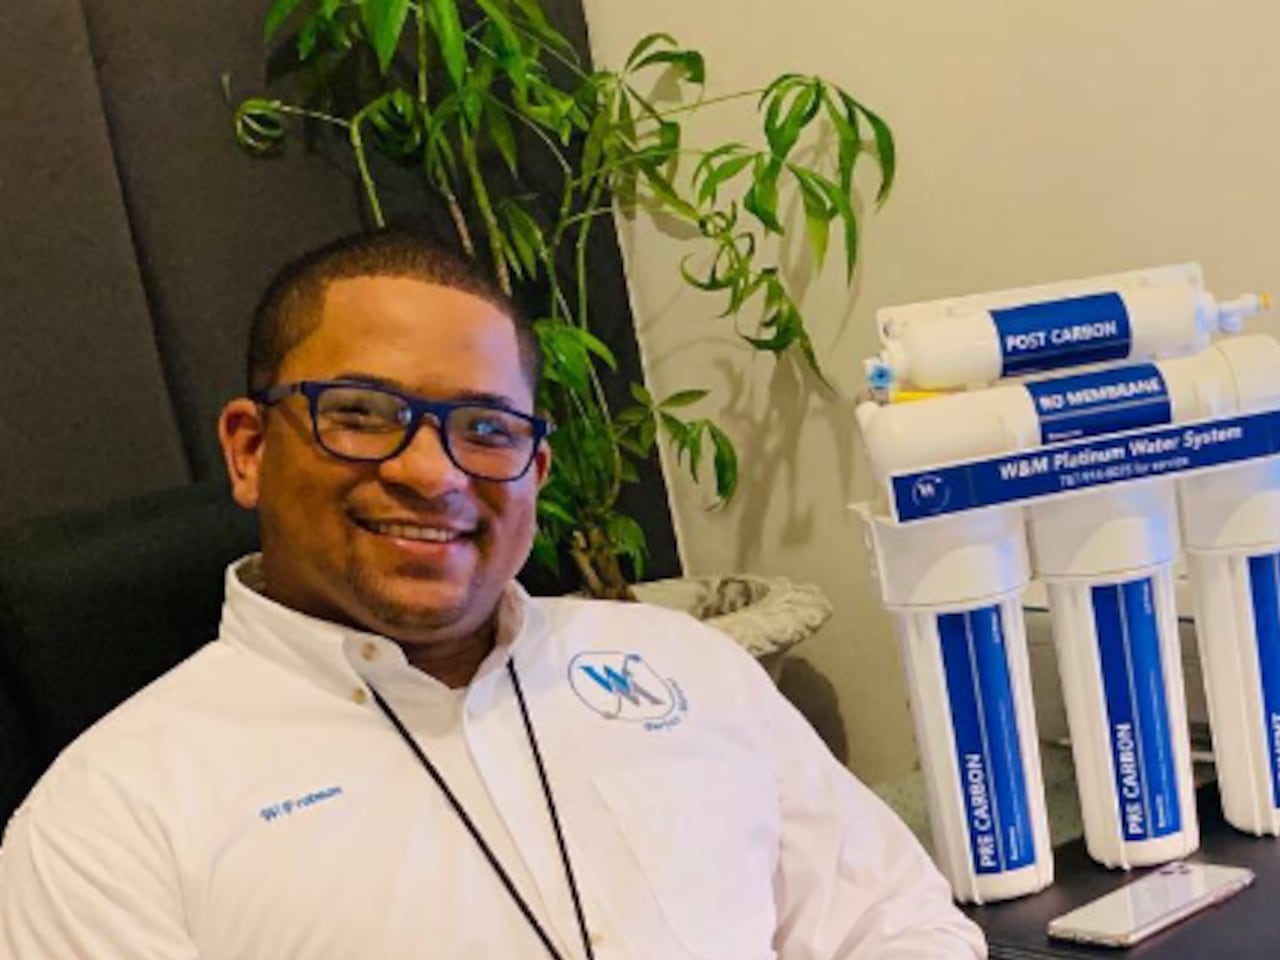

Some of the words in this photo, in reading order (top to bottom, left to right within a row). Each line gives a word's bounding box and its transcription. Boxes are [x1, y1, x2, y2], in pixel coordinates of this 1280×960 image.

[1006, 332, 1047, 352] POST
[1051, 320, 1118, 345] CARBON
[1066, 376, 1162, 405] MEMBRANE
[1054, 447, 1126, 471] Platinum
[1128, 436, 1180, 457] Water
[1182, 426, 1243, 451] System
[1116, 723, 1142, 800] CARBON
[964, 753, 992, 830] CARBON
[1125, 801, 1145, 835] PRE
[978, 833, 997, 868] PRE
